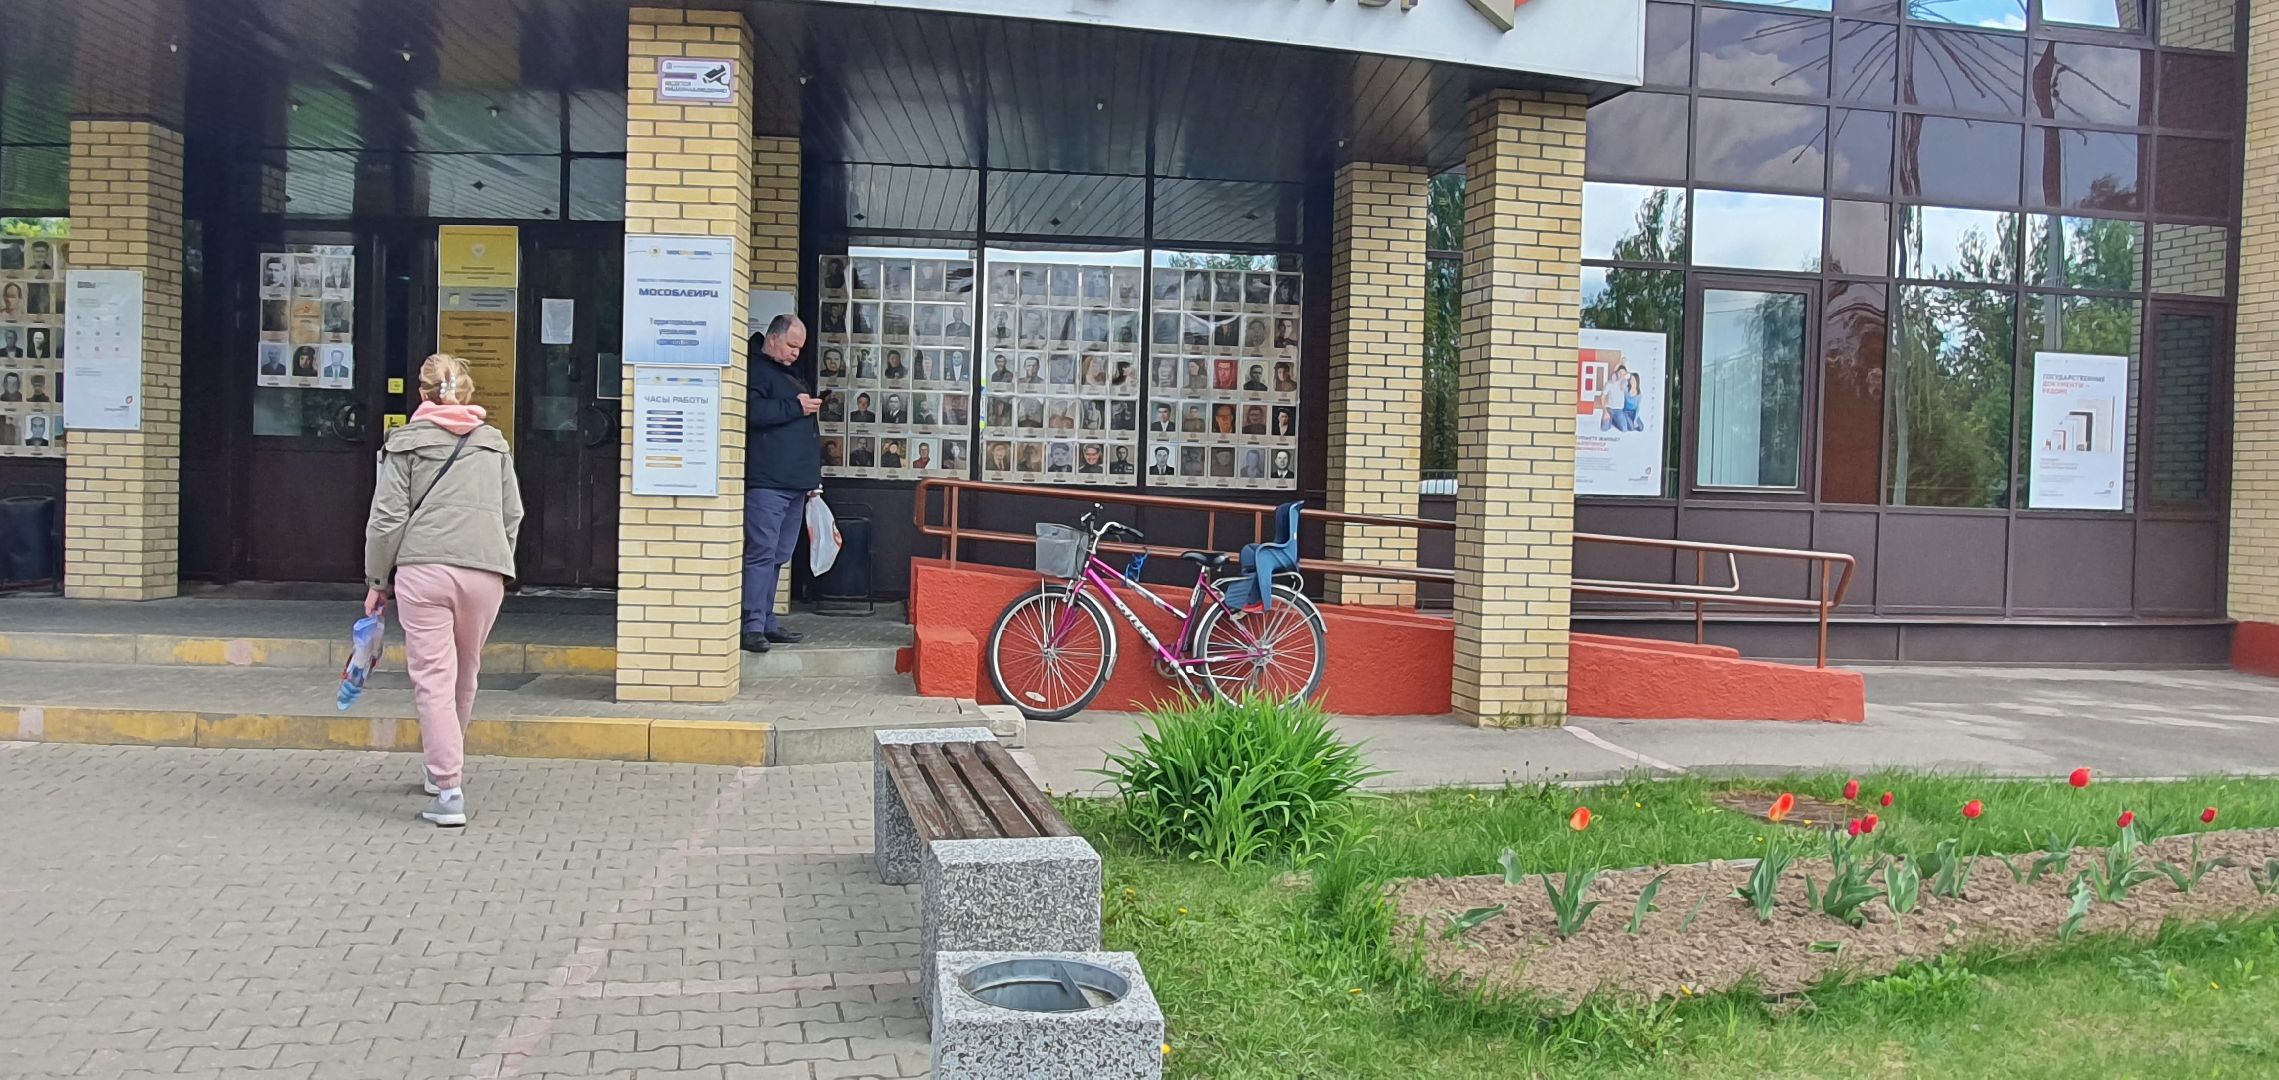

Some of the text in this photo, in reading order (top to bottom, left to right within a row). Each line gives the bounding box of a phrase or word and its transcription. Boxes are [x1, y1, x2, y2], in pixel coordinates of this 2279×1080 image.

[638, 287, 719, 298] МОСОБЛЕИРЦ
[644, 395, 709, 404] ЧАСЫ РАБОТЫ
